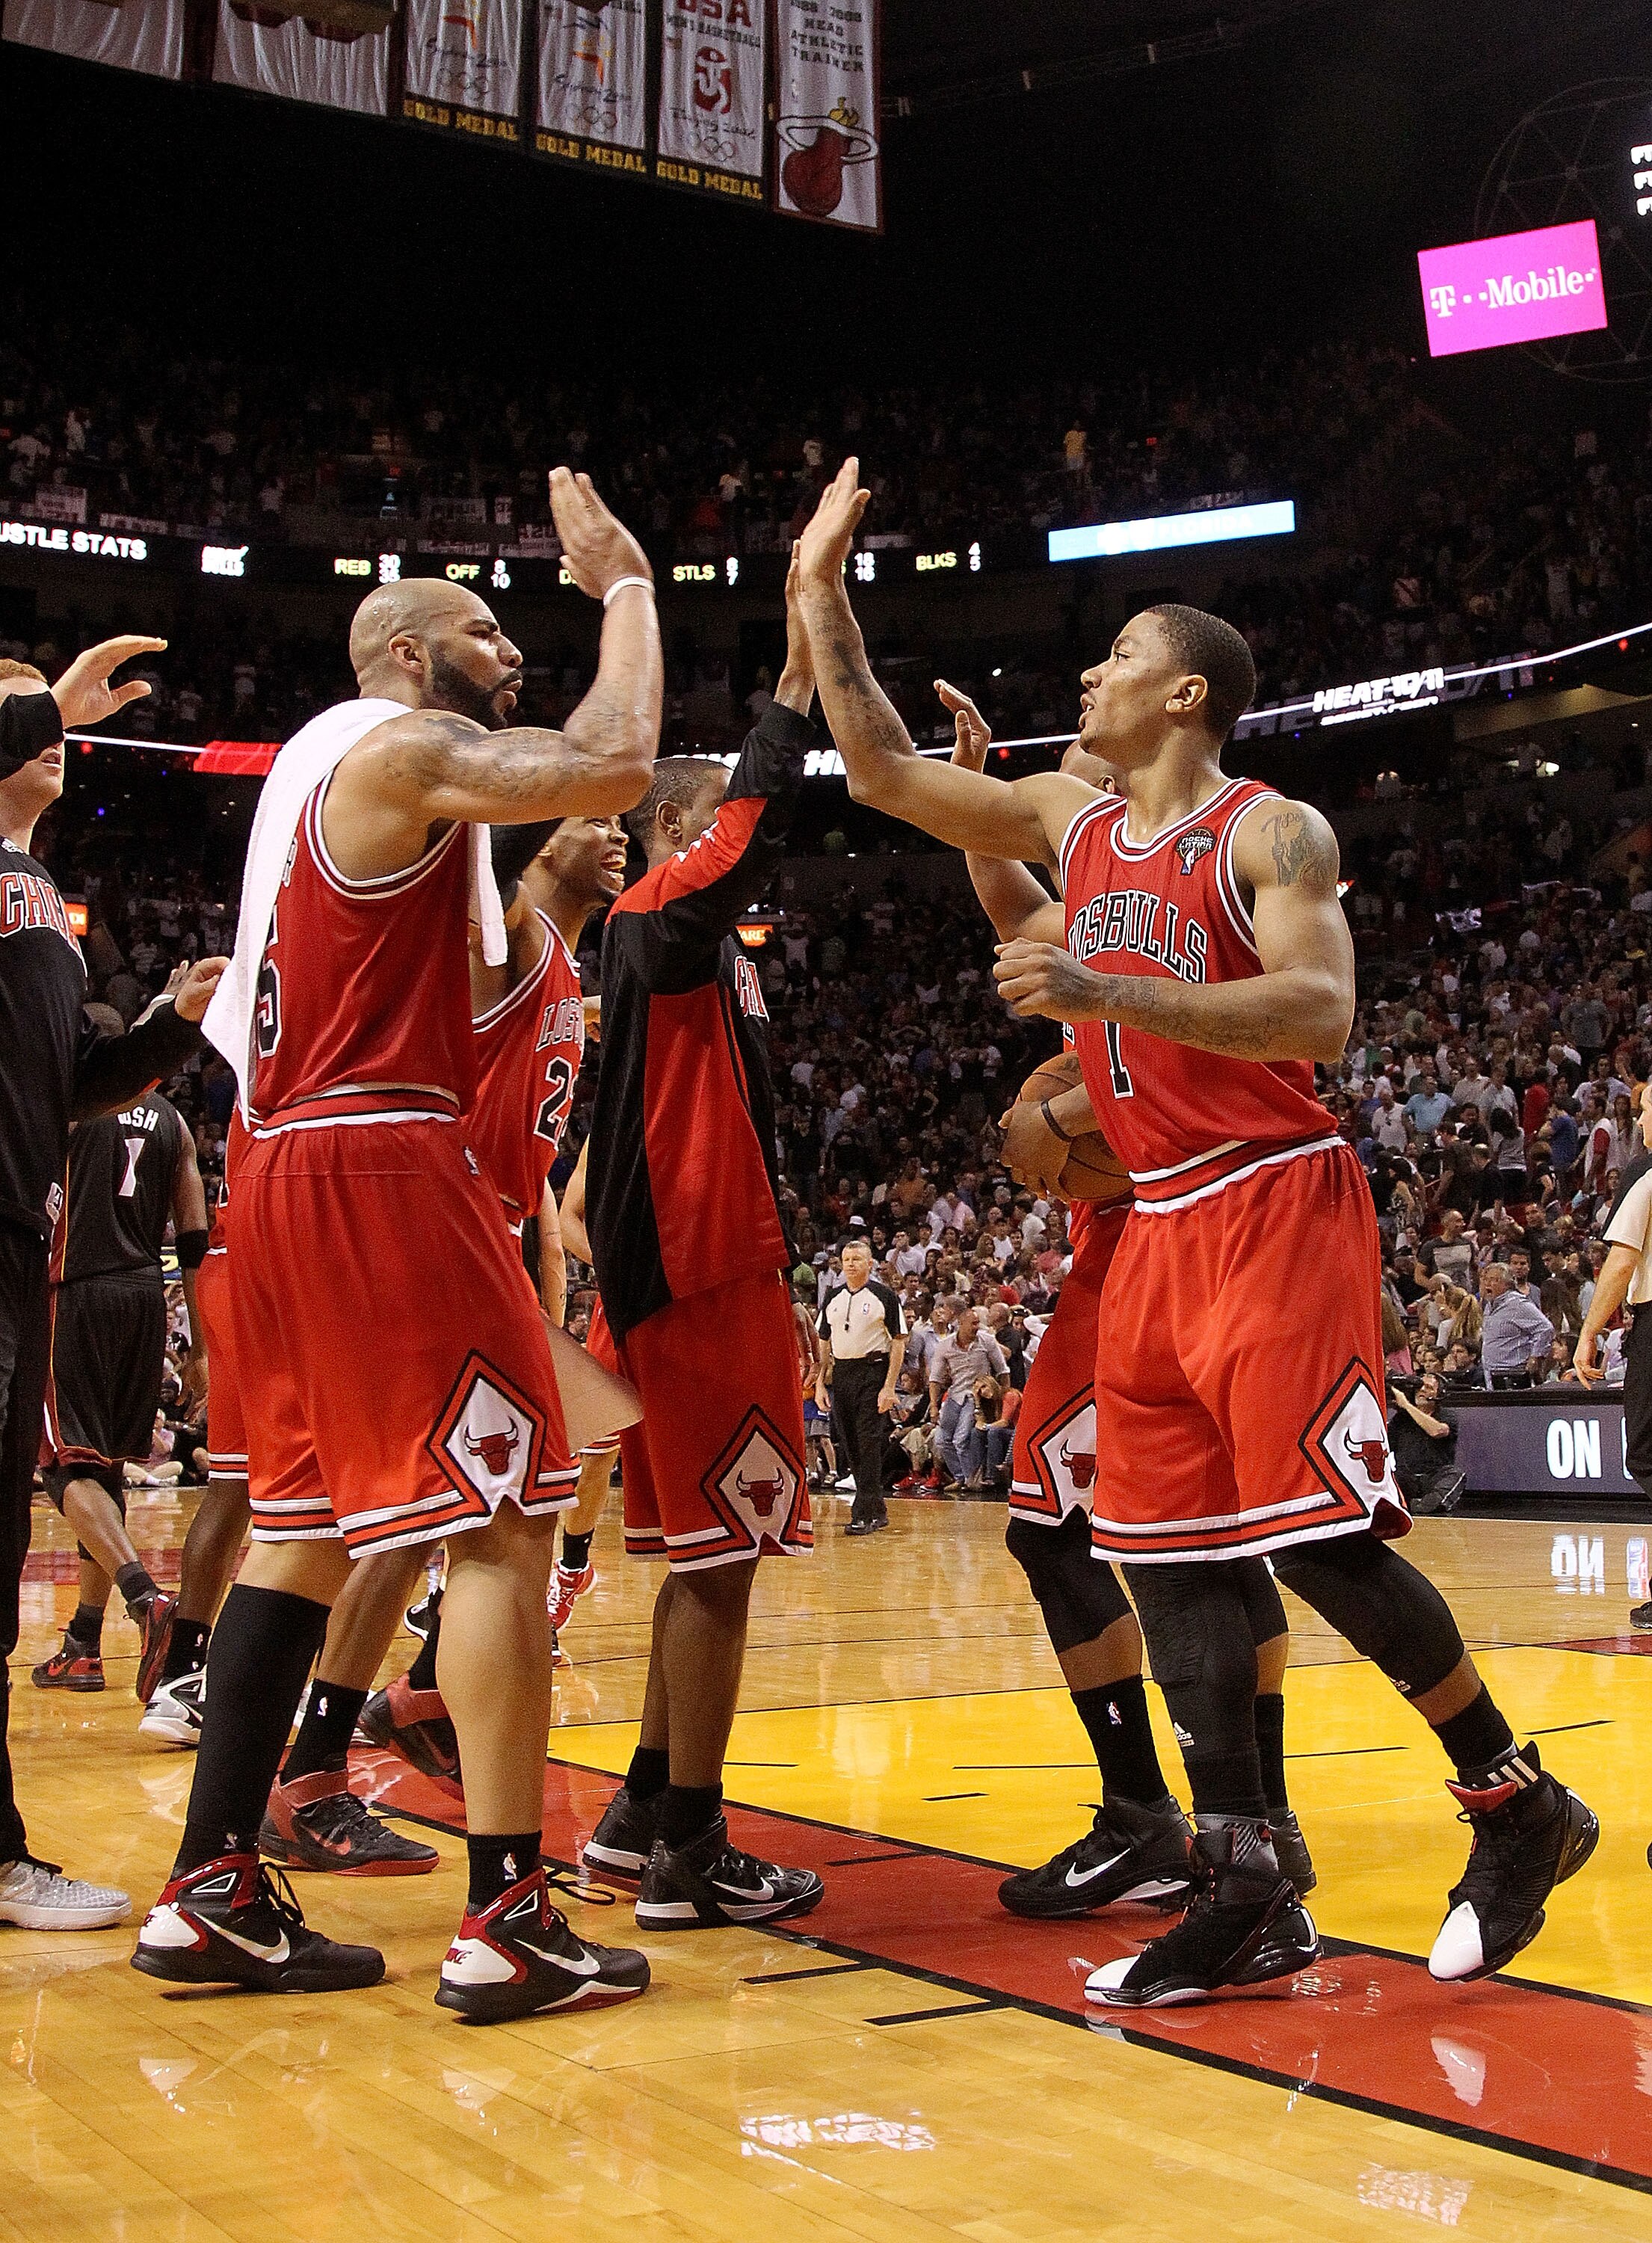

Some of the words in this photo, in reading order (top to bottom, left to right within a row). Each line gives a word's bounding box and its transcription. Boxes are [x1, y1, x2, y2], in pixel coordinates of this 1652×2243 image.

[804, 18, 844, 37] HEAD
[791, 30, 863, 56] ATHLETIC
[791, 46, 863, 72] TRAINER
[403, 99, 449, 126] GOLD
[455, 111, 519, 141] MEDAL
[535, 132, 580, 159] GOLD
[585, 144, 647, 173] MEDAL
[656, 161, 700, 185] GOLD
[704, 171, 764, 200] MEDAL
[72, 530, 147, 561] STATS
[968, 542, 981, 556] 4
[334, 559, 372, 576] REB
[916, 552, 957, 571] BLKS
[970, 555, 981, 571] 5
[446, 564, 481, 580] OFF
[490, 573, 511, 589] 10
[673, 564, 716, 582] STLS
[727, 570, 739, 585] 7
[1546, 1418, 1603, 1480] ON
